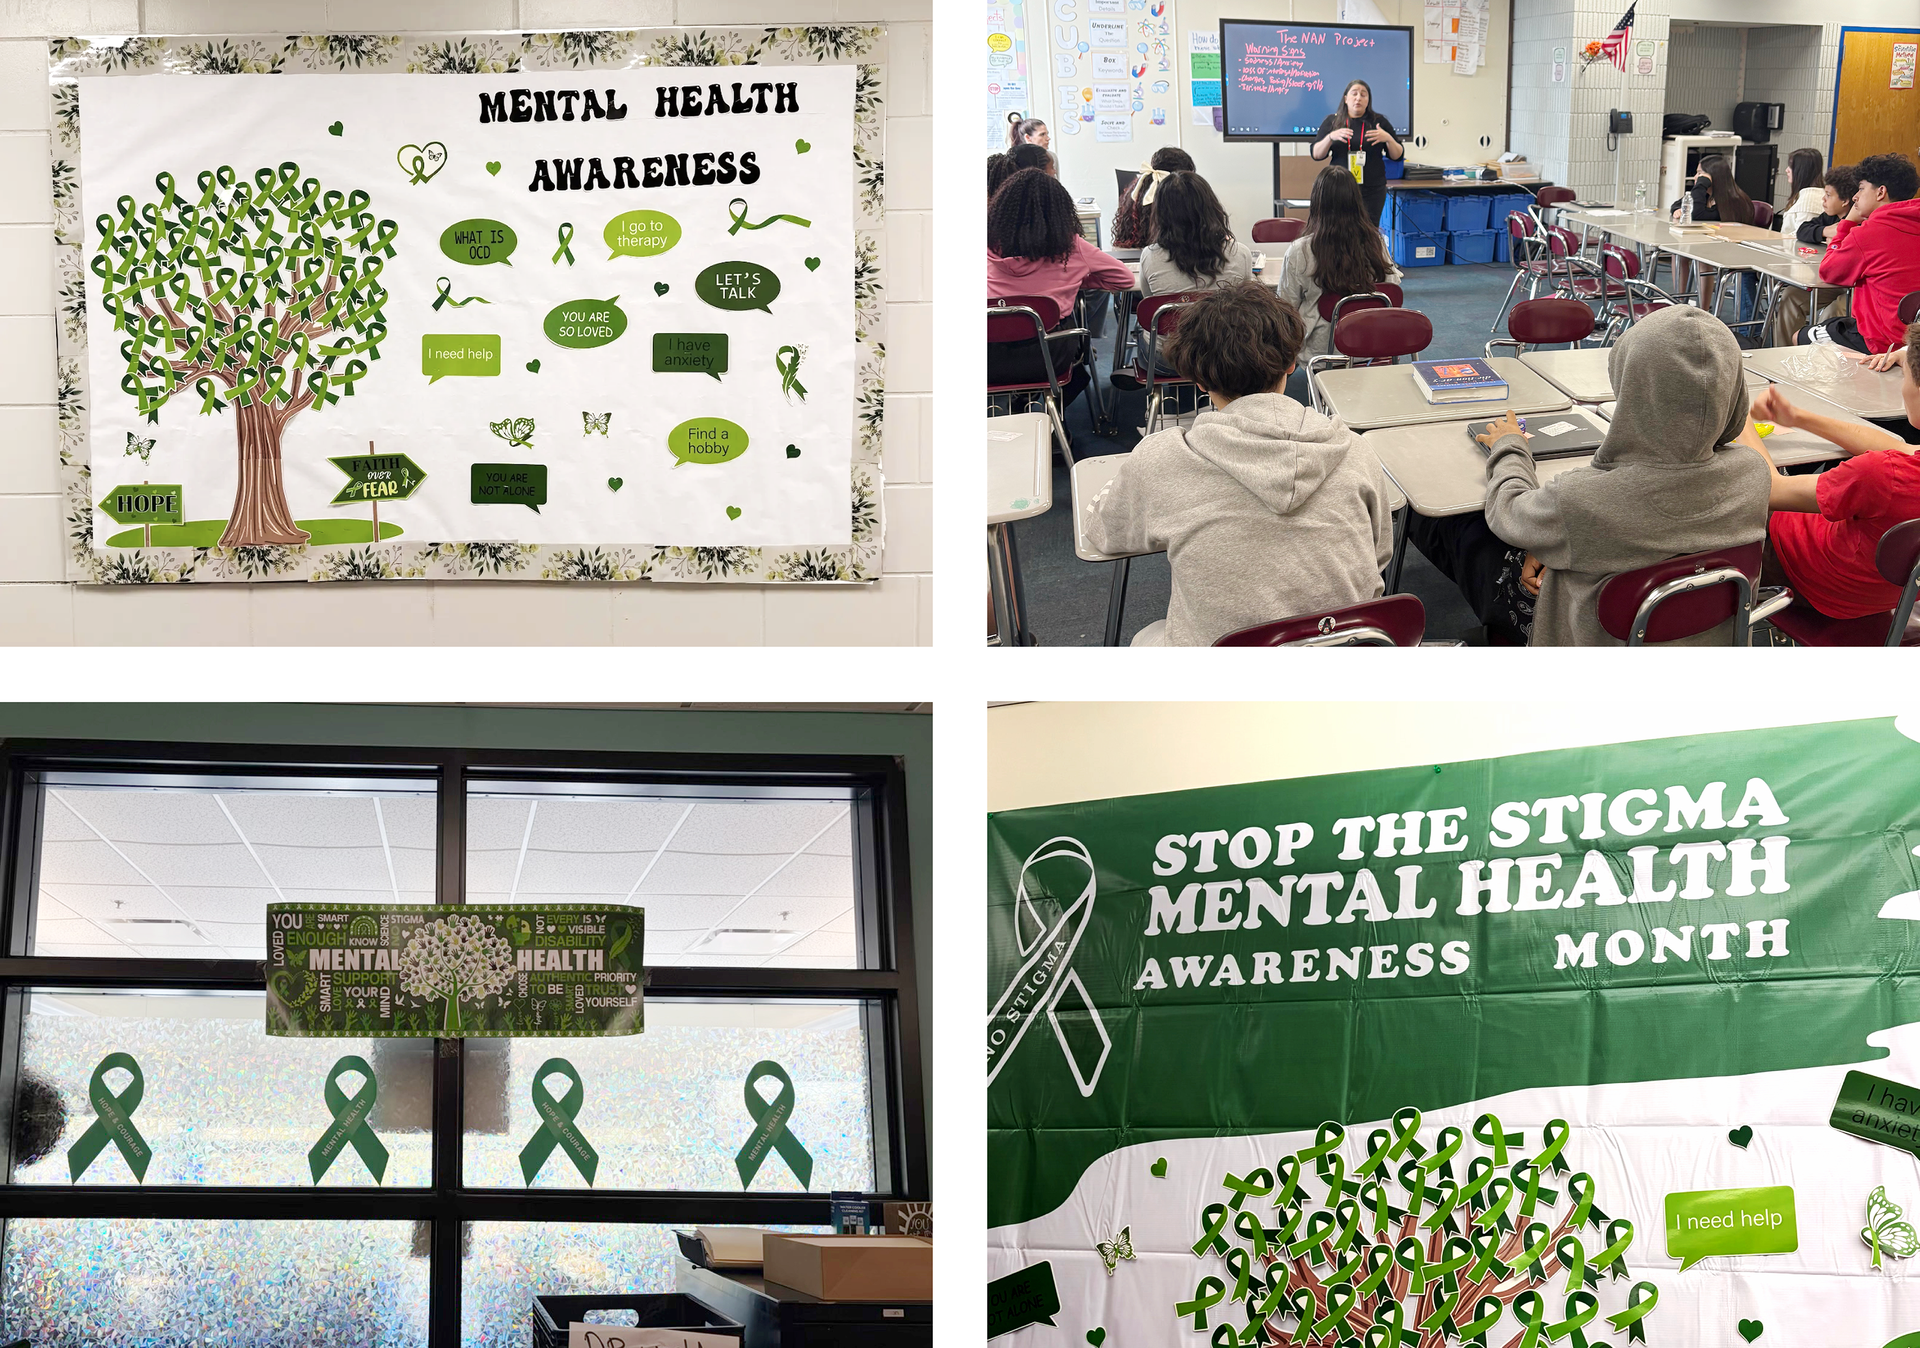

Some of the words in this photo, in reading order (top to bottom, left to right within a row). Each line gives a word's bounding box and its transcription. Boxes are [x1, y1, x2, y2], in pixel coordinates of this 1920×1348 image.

[1192, 32, 1208, 44] How
[1210, 34, 1219, 44] do
[1276, 29, 1298, 45] The
[1301, 32, 1326, 46] NAN
[1334, 32, 1376, 48] Project
[1245, 43, 1278, 56] Warning
[1281, 45, 1306, 57] Signs
[479, 88, 628, 123] MENTAL
[655, 82, 800, 118] HEALTH
[528, 151, 761, 192] AWARENESS
[621, 221, 625, 233] I
[629, 222, 647, 236] go
[649, 220, 664, 232] to
[454, 230, 484, 246] WHAT
[490, 229, 504, 245] IS
[617, 233, 668, 249] therapy
[469, 246, 491, 260] OCD
[715, 273, 761, 286] LET'S
[720, 287, 757, 300] TALK
[562, 312, 586, 323] YOU
[588, 311, 610, 323] ARE
[559, 326, 574, 338] SO
[576, 326, 614, 338] LOVED
[679, 338, 711, 352] have
[435, 348, 465, 360] need
[467, 347, 493, 362] help
[664, 353, 715, 369] anxiety
[688, 428, 717, 441] Find
[721, 430, 729, 441] a
[688, 441, 730, 457] hobby
[352, 457, 400, 472] FAITH
[367, 471, 392, 480] OVER
[486, 472, 507, 484] YOU
[509, 472, 528, 484] ARE
[362, 480, 399, 498] FEAR
[478, 485, 501, 497] NOT
[503, 484, 536, 497] ALONE
[117, 495, 178, 513] HOPE
[1152, 822, 1314, 877] STOP
[1331, 807, 1468, 860] THE
[1488, 777, 1790, 848] STIGMA
[1143, 865, 1437, 936] MENTAL
[1455, 836, 1791, 916] HEALTH
[272, 913, 303, 929] YOU
[305, 913, 315, 929] ARE
[317, 914, 350, 922] SMART
[390, 914, 425, 924] STIGMA
[535, 914, 545, 934] NOT
[547, 914, 580, 924] EVERY
[583, 914, 592, 924] IS
[380, 914, 390, 947] SCIENCE
[391, 925, 400, 946] NO
[568, 925, 605, 935] VISIBLE
[286, 931, 347, 946] ENOUGH
[349, 937, 379, 946] KNOW
[535, 935, 607, 947] DISABILITY
[272, 930, 285, 967] LOVED
[1132, 940, 1470, 990] AWARENESS
[1553, 918, 1791, 970] MONTH
[309, 949, 402, 970] MENTAL
[517, 949, 604, 971] HEALTH
[332, 972, 398, 985] SUPPORT
[518, 972, 528, 998] CHOOSE
[530, 972, 593, 983] AUTHENTIC
[594, 972, 637, 983] PRIORITY
[1006, 939, 1067, 1024] STIGMA
[320, 972, 331, 1012] SMART
[343, 986, 378, 998] YOUR
[530, 984, 546, 995] TO
[547, 984, 564, 995] BE
[585, 984, 623, 995] TRUST
[332, 986, 342, 1012] LOVE
[380, 986, 391, 1018] MIND
[565, 985, 574, 1012] SMART
[575, 985, 584, 1014] LOVED
[585, 997, 638, 1007] YOURSELF
[1866, 1083, 1876, 1102] I
[1880, 1087, 1920, 1116] hav
[97, 1097, 116, 1118] HOPE
[112, 1115, 120, 1125] &
[117, 1122, 144, 1158] COURAGE
[321, 1124, 346, 1158] MENTAL
[343, 1098, 367, 1128] HEALTH
[541, 1101, 560, 1122] HOPE
[556, 1120, 564, 1130] &
[562, 1127, 591, 1162] COURAGE
[748, 1132, 770, 1162] MENTAL
[765, 1103, 786, 1134] HEALTH
[1851, 1109, 1920, 1149] anxiet
[1676, 1214, 1681, 1230] I
[1687, 1210, 1734, 1230] need
[1740, 1208, 1783, 1230] help
[1011, 1280, 1032, 1300] ARE
[1007, 1294, 1045, 1320] ALONE
